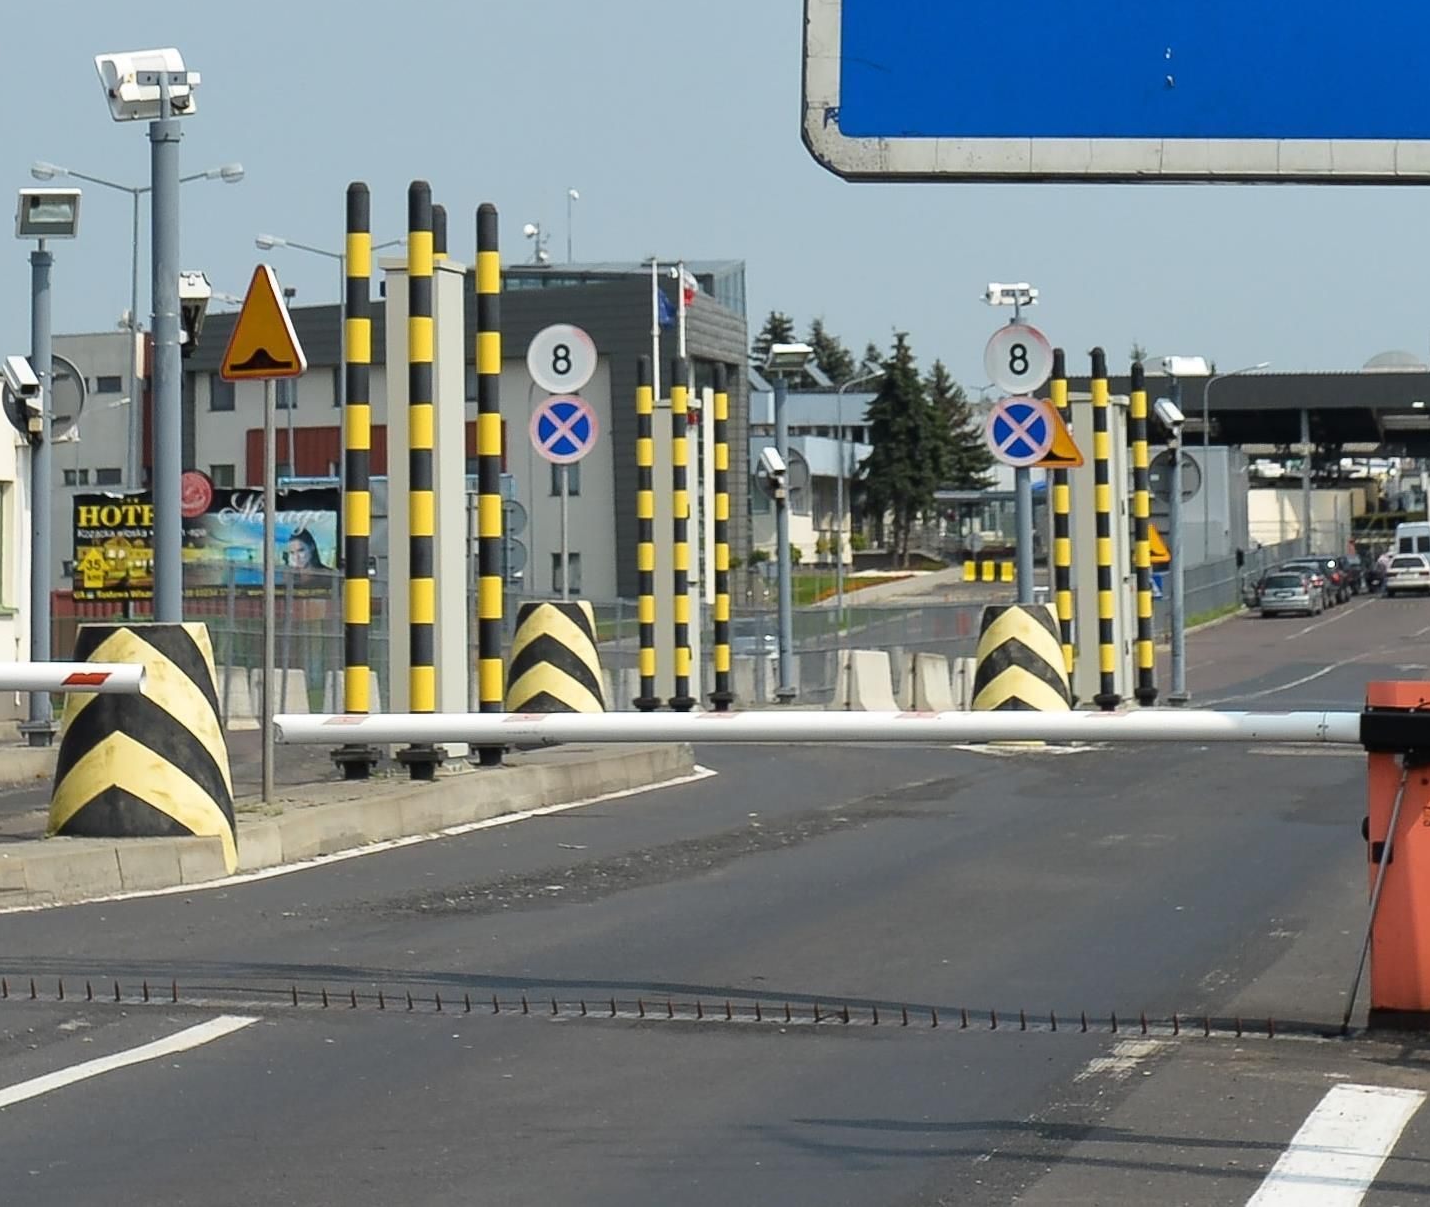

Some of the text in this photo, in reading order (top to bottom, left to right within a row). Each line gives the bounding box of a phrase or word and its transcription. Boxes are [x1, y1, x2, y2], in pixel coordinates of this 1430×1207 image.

[552, 344, 572, 375] 8
[1009, 343, 1029, 376] 8
[78, 505, 154, 527] HOTE
[85, 559, 102, 571] 35
